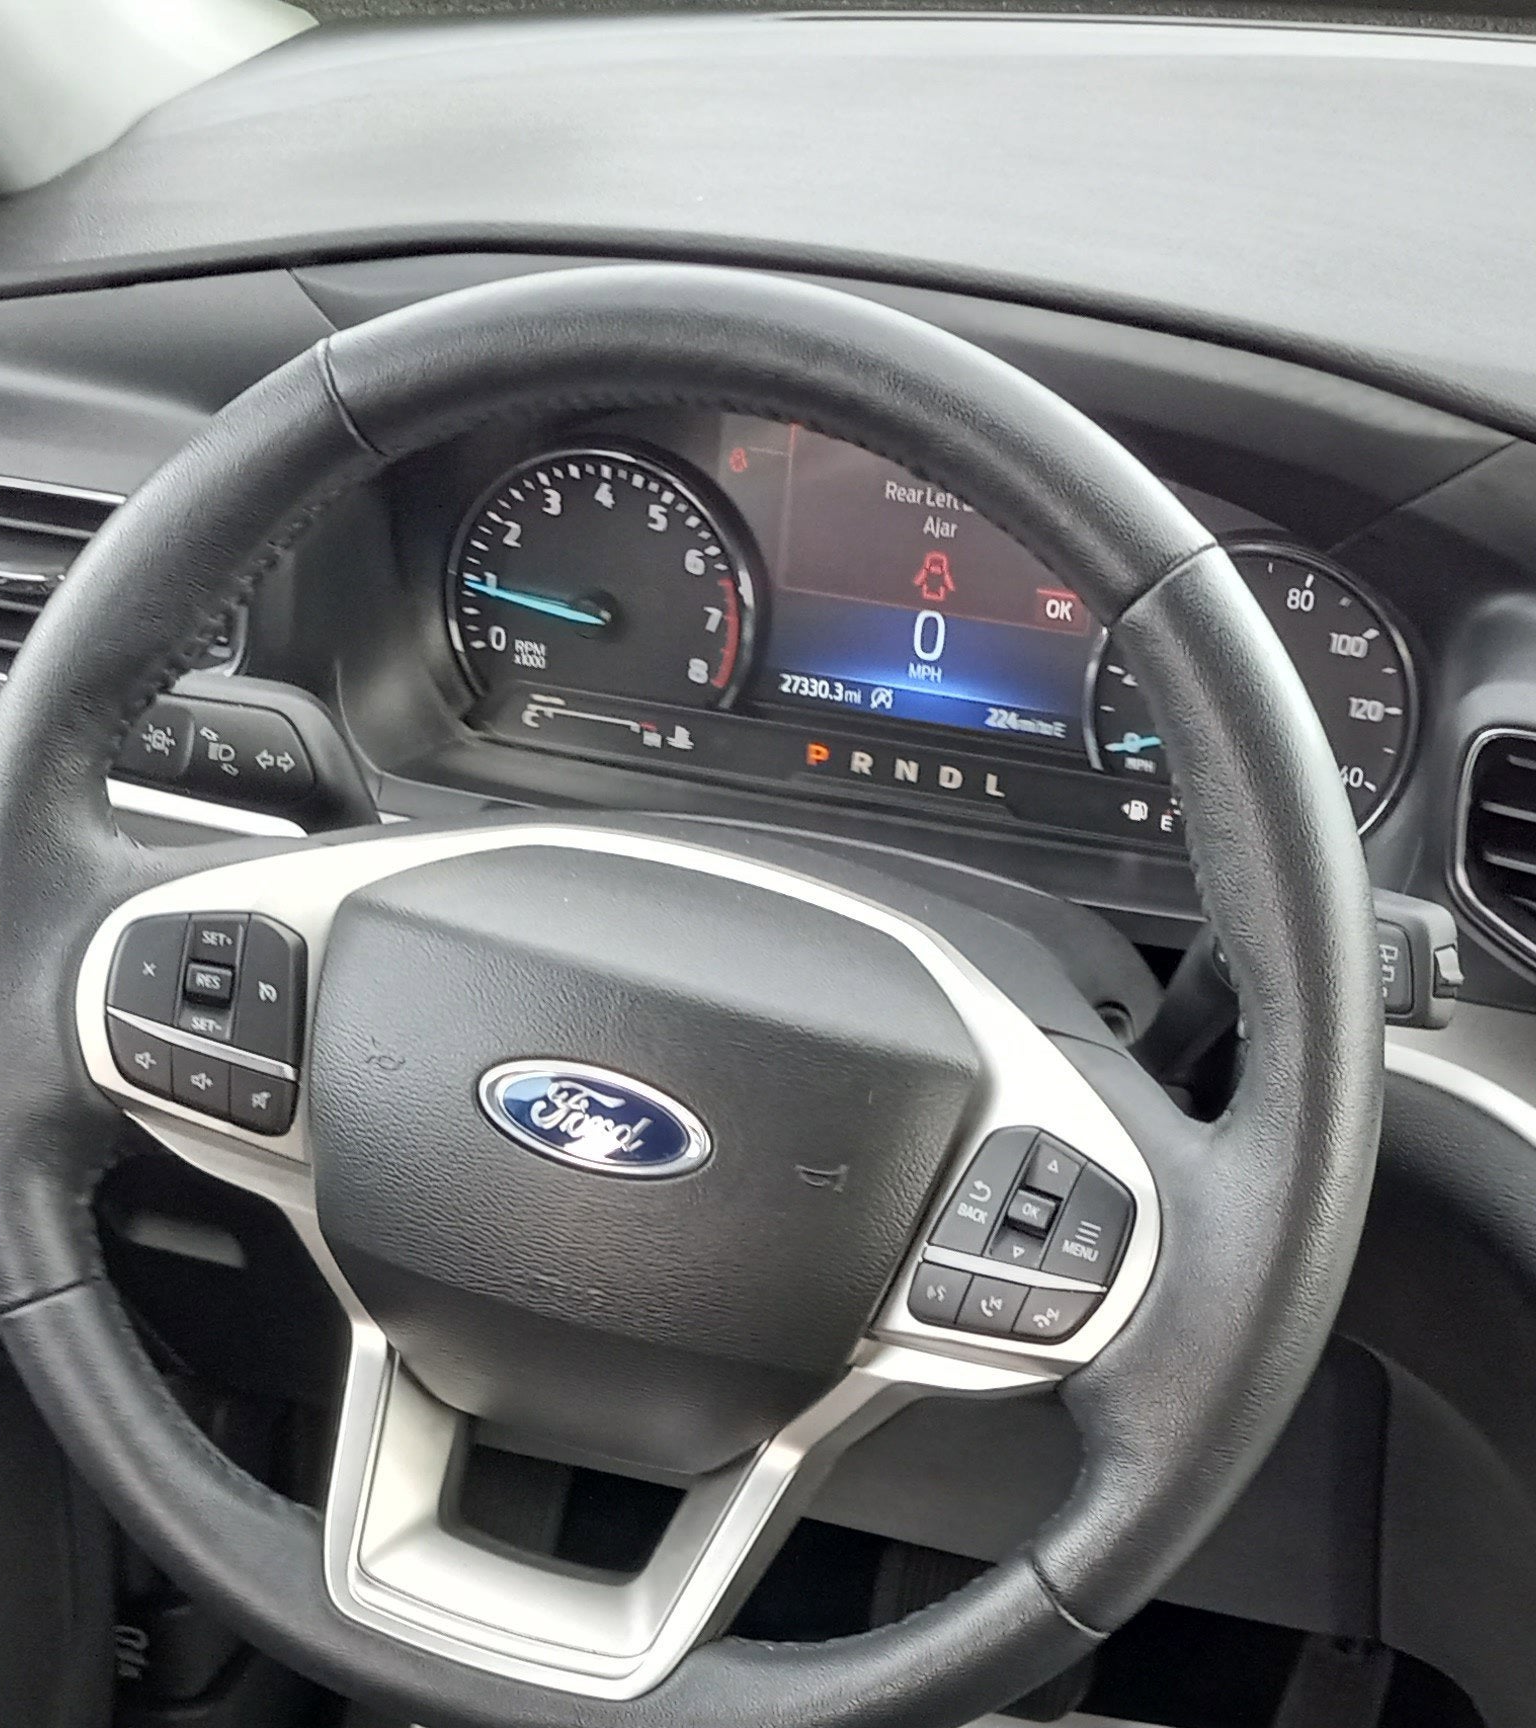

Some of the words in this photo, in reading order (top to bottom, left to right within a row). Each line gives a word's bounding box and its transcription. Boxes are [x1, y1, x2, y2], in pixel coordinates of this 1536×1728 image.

[542, 488, 562, 516] 3
[594, 482, 615, 509] 4
[885, 480, 924, 505] Rear
[647, 504, 668, 532] 5
[923, 515, 958, 539] Ajar
[502, 520, 522, 548] 2
[684, 549, 706, 576] 6
[1045, 599, 1073, 622] OK
[1286, 587, 1315, 612] 80
[703, 606, 723, 633] 7
[488, 626, 507, 651] 0
[913, 609, 946, 661] 0
[1329, 631, 1368, 658] 100
[687, 657, 709, 684] 8
[908, 662, 943, 683] MPH
[1349, 697, 1384, 722] 120
[806, 743, 830, 765] P
[850, 751, 874, 775] R
[894, 758, 919, 783] N
[938, 765, 963, 789] D
[985, 773, 1006, 797] L
[1161, 814, 1173, 833] E
[195, 973, 221, 990] RES
[530, 1080, 653, 1152] Ford
[957, 1202, 988, 1225] BACK
[1022, 1205, 1040, 1220] OK
[1063, 1239, 1099, 1263] MENU
